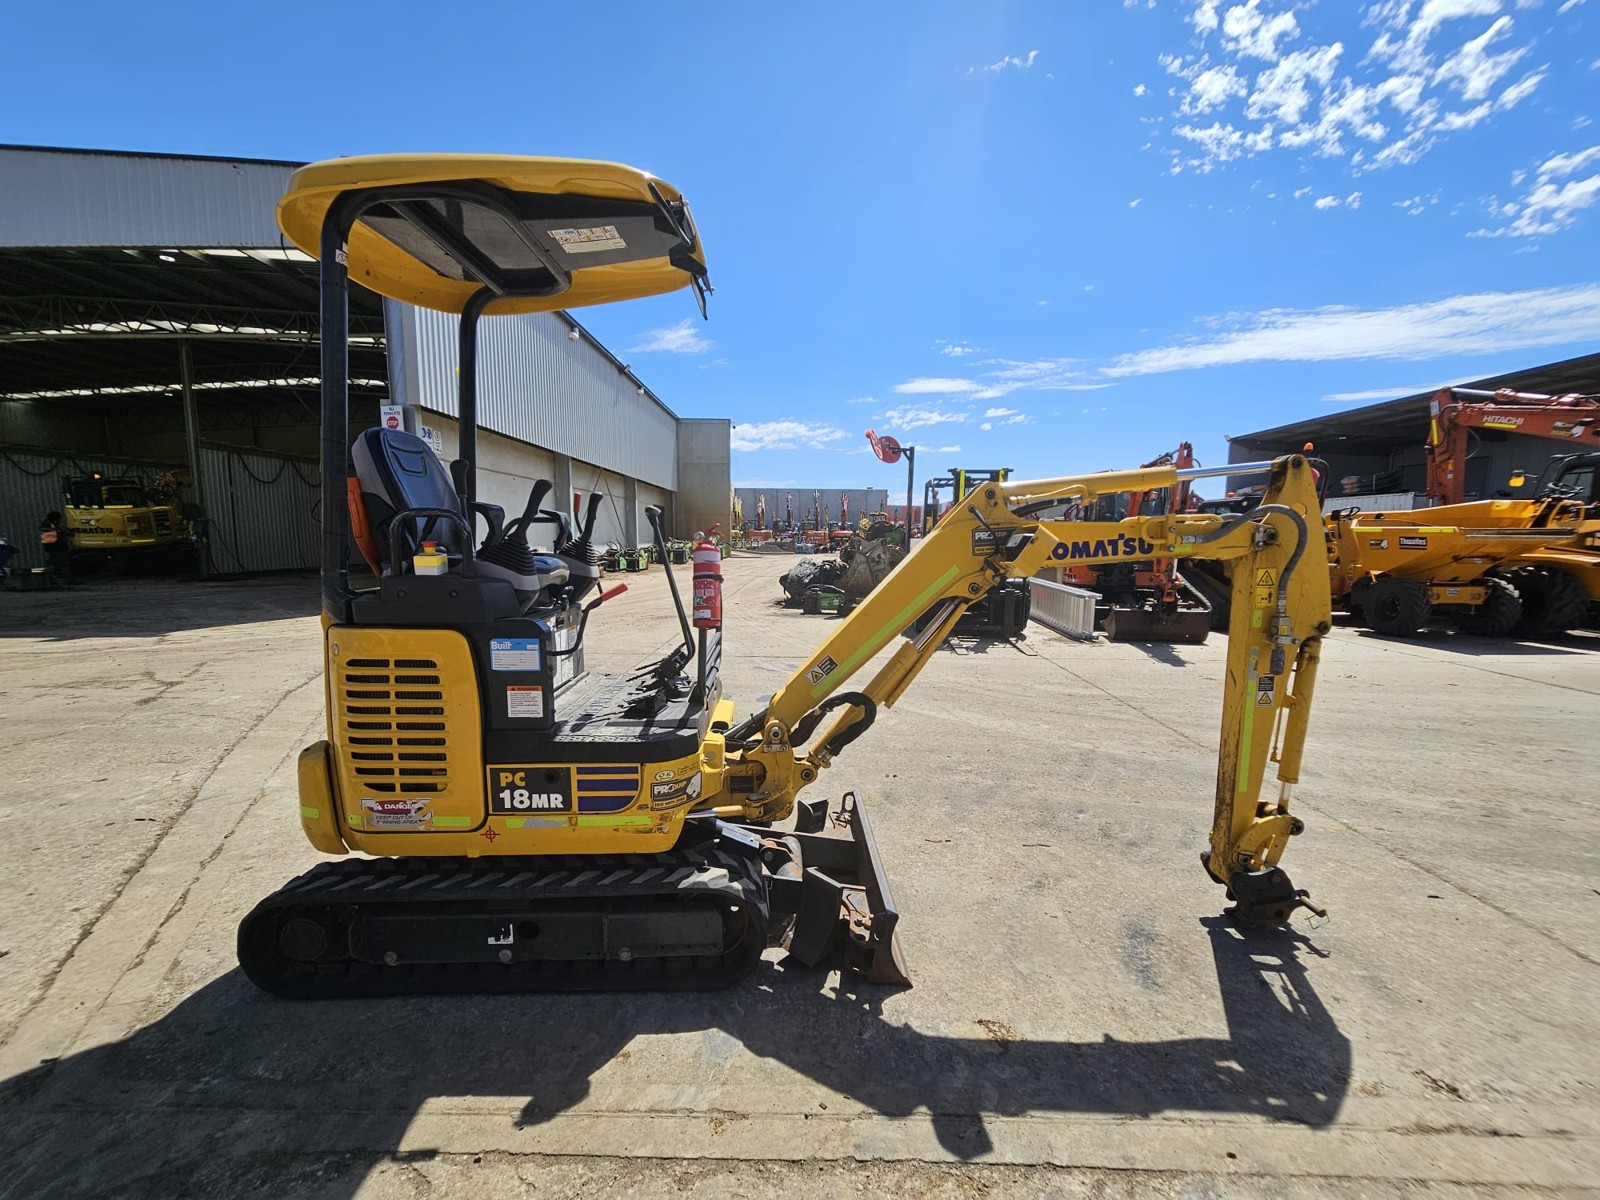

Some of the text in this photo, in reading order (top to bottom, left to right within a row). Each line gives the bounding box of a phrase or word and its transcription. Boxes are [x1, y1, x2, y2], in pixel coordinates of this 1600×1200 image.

[1482, 415, 1524, 425] HITACHI
[1046, 533, 1155, 561] OMATSU
[500, 772, 525, 787] PC
[500, 789, 564, 809] 18MR
